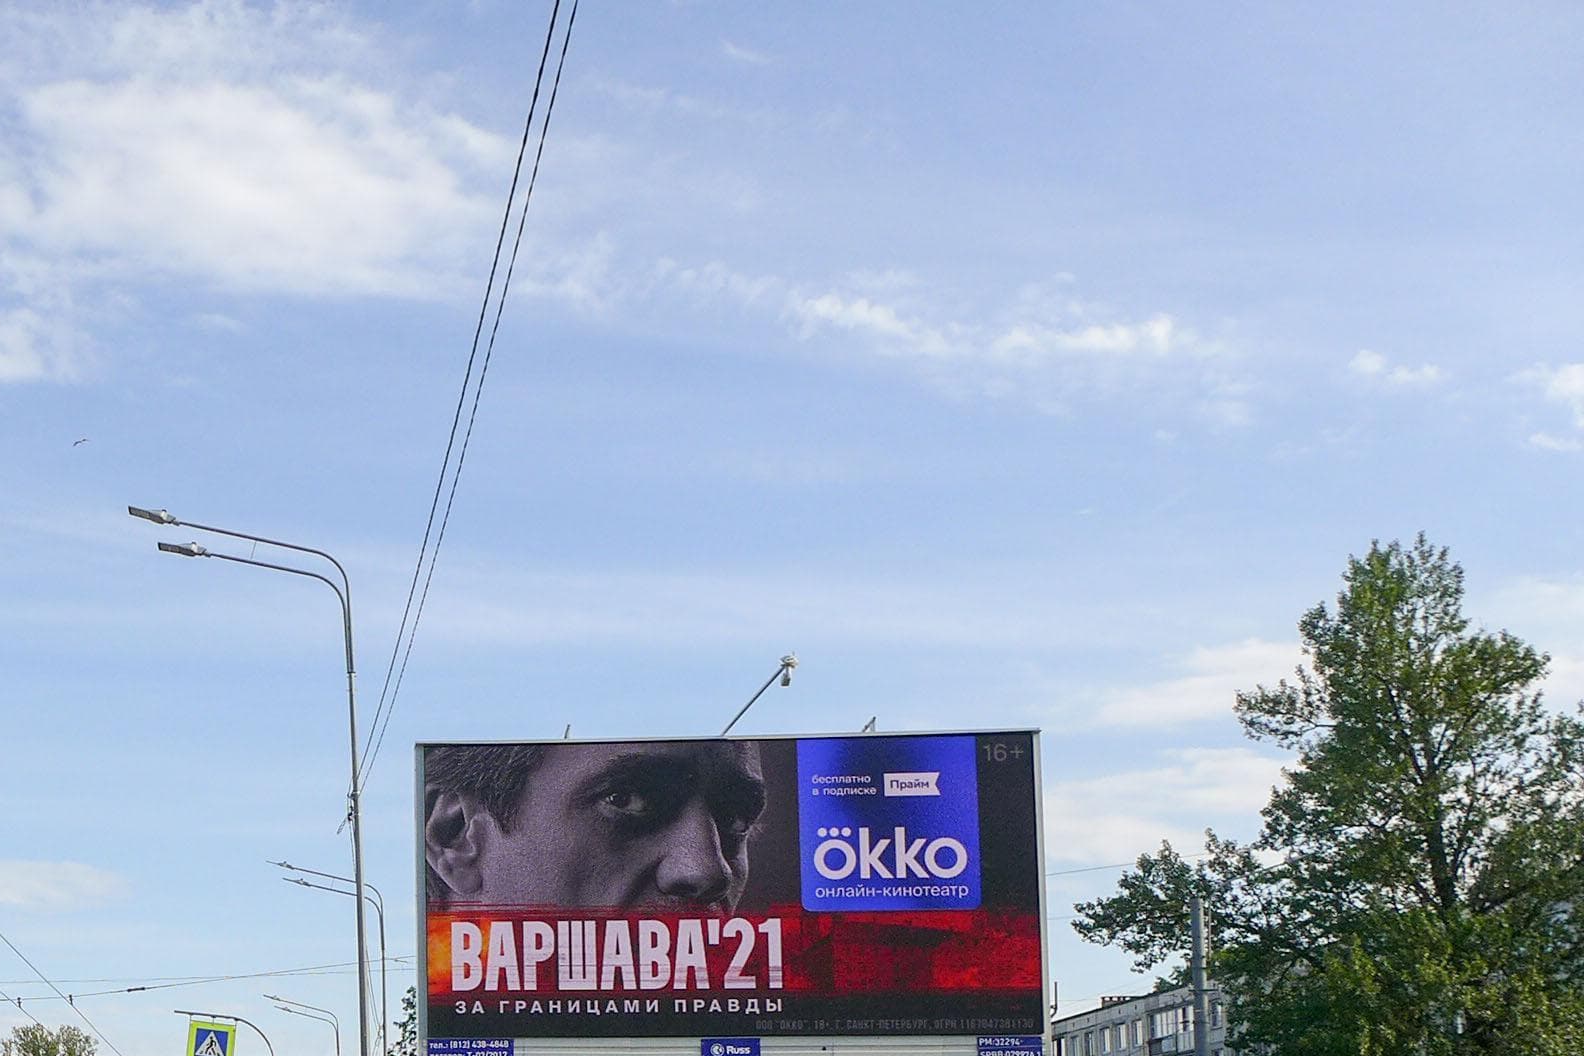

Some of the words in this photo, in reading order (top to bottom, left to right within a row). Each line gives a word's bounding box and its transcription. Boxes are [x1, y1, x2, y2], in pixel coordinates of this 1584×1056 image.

[983, 743, 1024, 762] 16+
[811, 774, 871, 784] бесплатно
[889, 778, 930, 791] Прайм
[812, 787, 819, 796] в
[823, 786, 877, 797] подписке
[815, 884, 969, 899] онлайн-кинотеатр
[450, 917, 784, 992] ВАРШАВА'21
[455, 1000, 485, 1015] ЗА
[499, 999, 660, 1016] ГРАНИЦАМИ
[674, 998, 783, 1015] ПРАВДЫ
[449, 1040, 470, 1049] (812)
[726, 1045, 751, 1055] Russ
